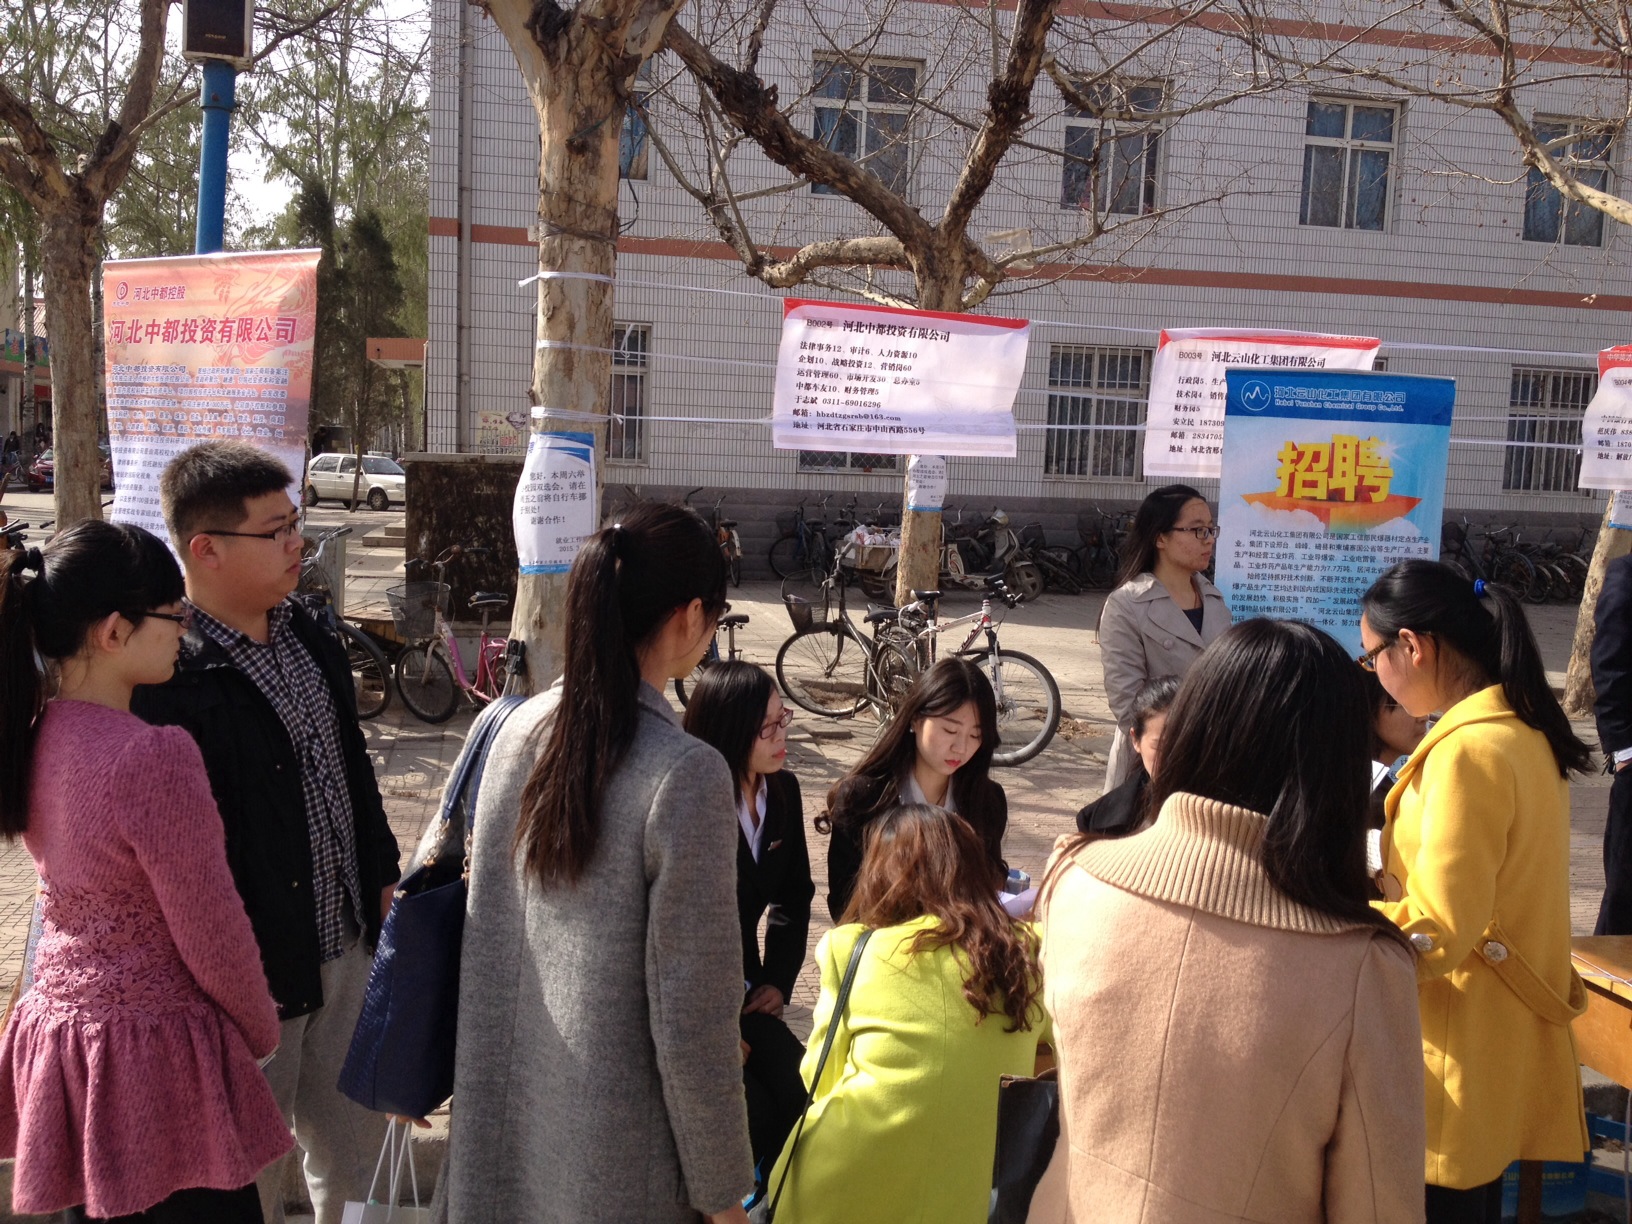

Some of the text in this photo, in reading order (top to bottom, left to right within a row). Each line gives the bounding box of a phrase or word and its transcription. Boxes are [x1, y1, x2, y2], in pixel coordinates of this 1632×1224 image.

[133, 286, 186, 301] 河北中都控股
[110, 316, 297, 345] 河北中都投资有限公司
[806, 319, 951, 342] B002号 河北中都投资有限公司
[1178, 350, 1326, 368] B003号 河北云山化工集团有限公司
[1175, 390, 1227, 401] 技术岗4、销售
[1273, 385, 1407, 404] 河北云山化工集团有限公司
[1173, 404, 1201, 413] 财务岗5
[1275, 399, 1295, 407] Hebei
[1295, 401, 1323, 409] Yunshan
[1323, 402, 1355, 410] Chemical
[1355, 403, 1377, 412] Group
[1172, 418, 1194, 426] 安立民
[1170, 431, 1223, 440] 邮箱：2834705
[1275, 432, 1394, 503] 招聘
[555, 536, 586, 544] 就业工作
